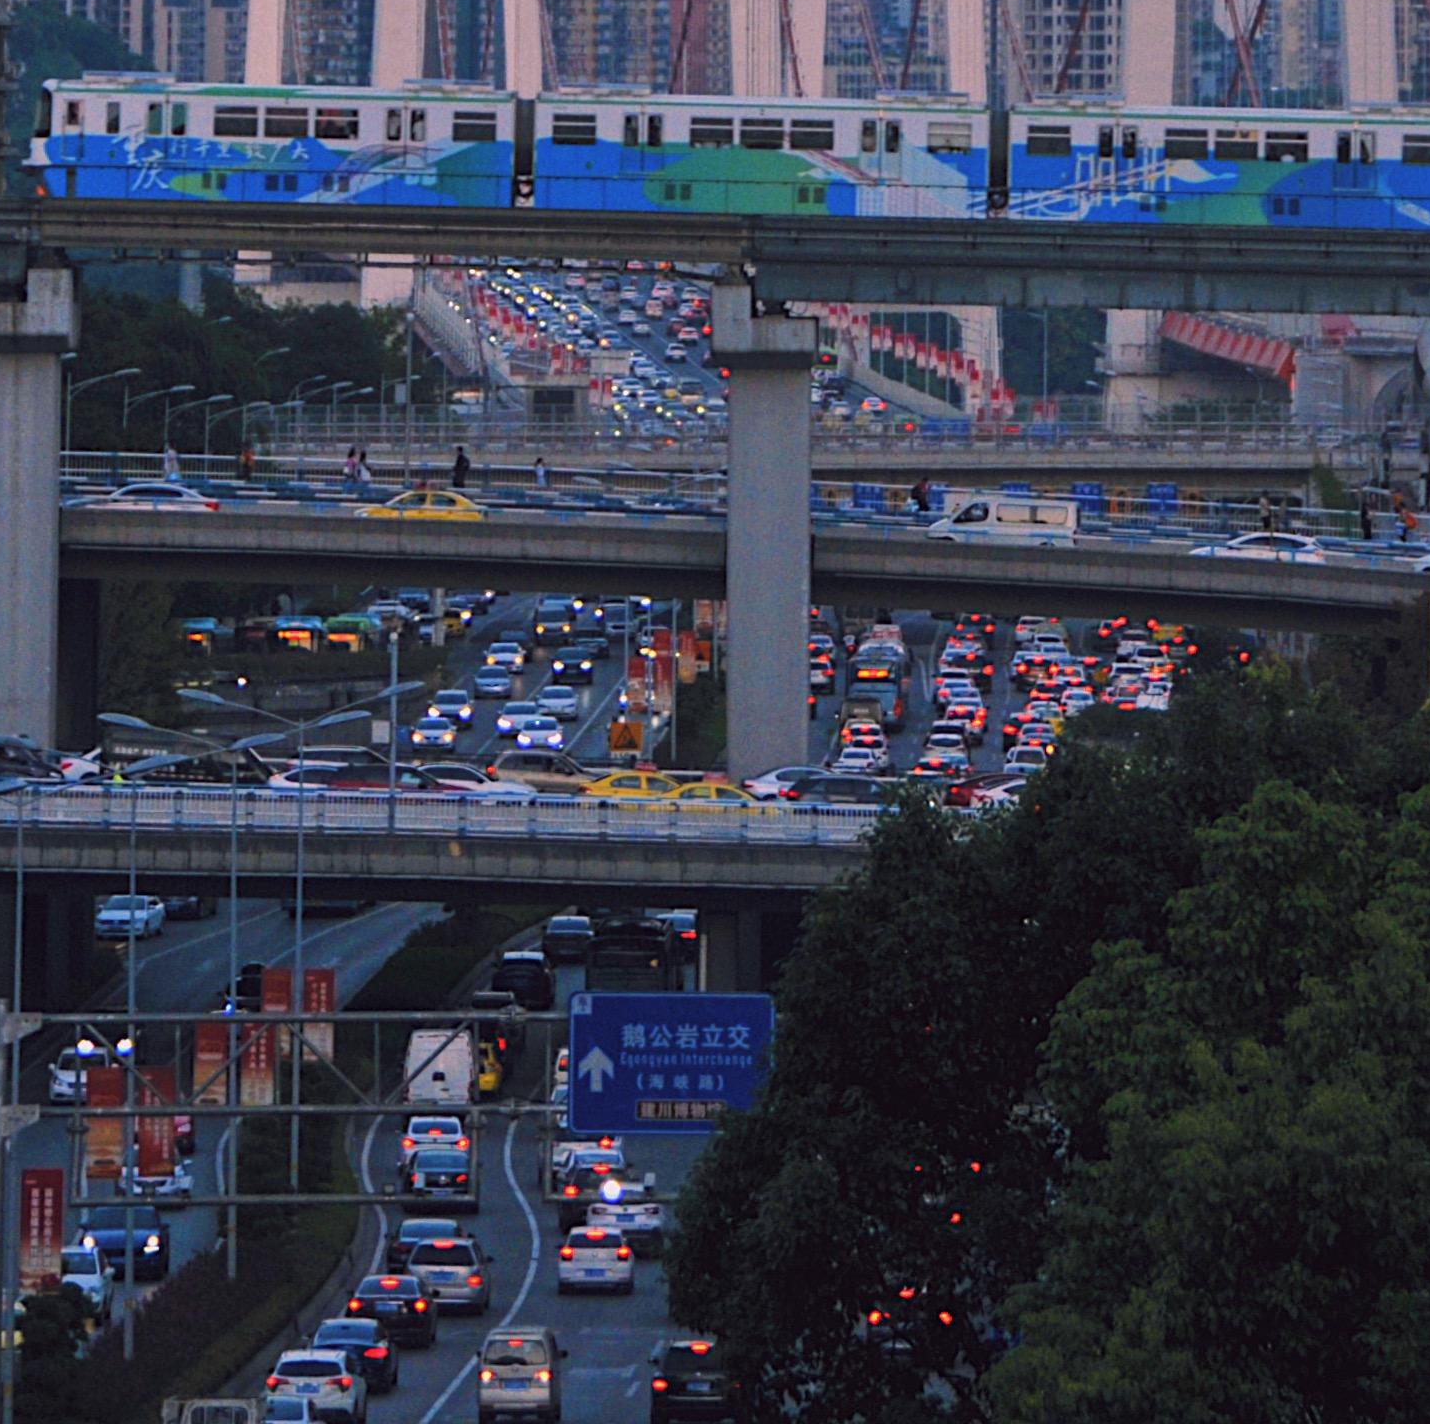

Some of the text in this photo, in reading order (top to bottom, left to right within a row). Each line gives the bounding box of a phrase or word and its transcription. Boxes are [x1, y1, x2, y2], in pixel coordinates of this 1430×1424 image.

[622, 1023, 751, 1049] 鹅公岩立交
[680, 1051, 753, 1068] Interchange
